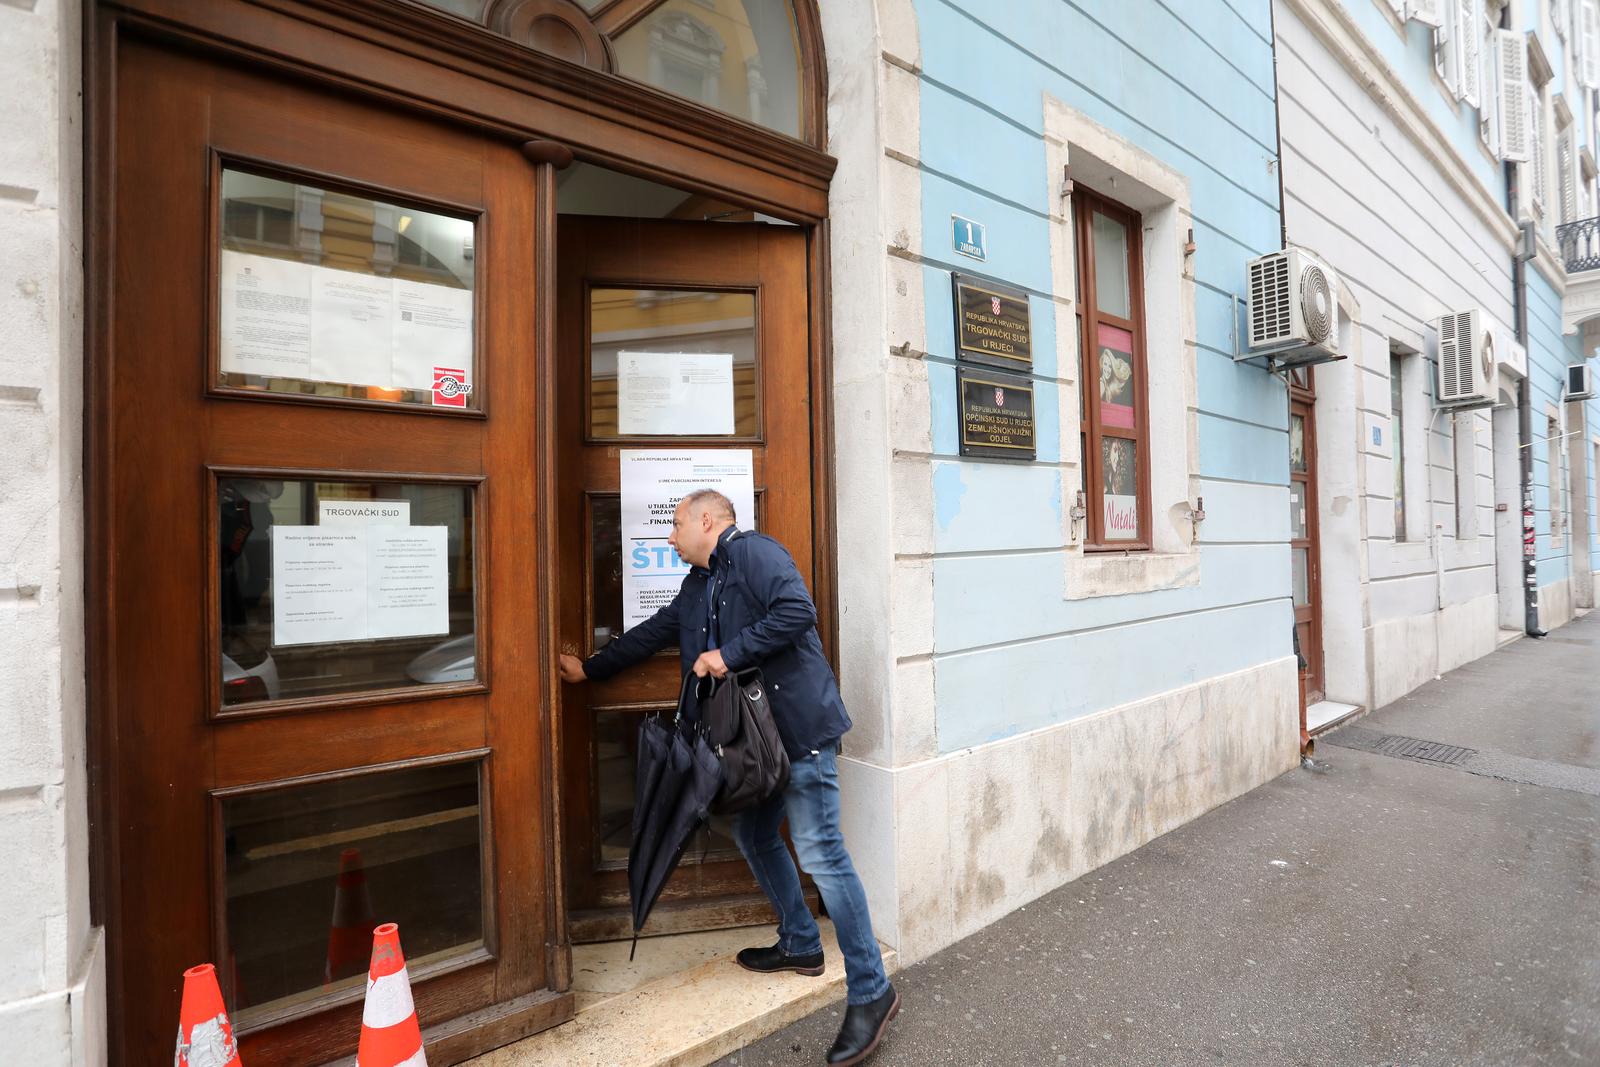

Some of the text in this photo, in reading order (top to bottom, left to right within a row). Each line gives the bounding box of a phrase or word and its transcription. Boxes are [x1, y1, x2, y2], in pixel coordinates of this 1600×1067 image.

[966, 222, 974, 245] 1
[965, 311, 1026, 332] REPUBLIKA HRVATSKA
[966, 323, 1027, 344] TRGOVAČKI SUD
[982, 339, 1014, 353] U RIJECI
[971, 405, 1028, 417] REPUBLIKA HRVATSKA
[965, 412, 1033, 428] OPĆINSKI SUD U RIJECI
[968, 423, 1033, 437] ZEMLJIŠNOKNJIŽNI
[990, 434, 1012, 443] ODJEL
[325, 508, 400, 517] TRGOVAČKI SUD
[1104, 499, 1136, 536] Natali
